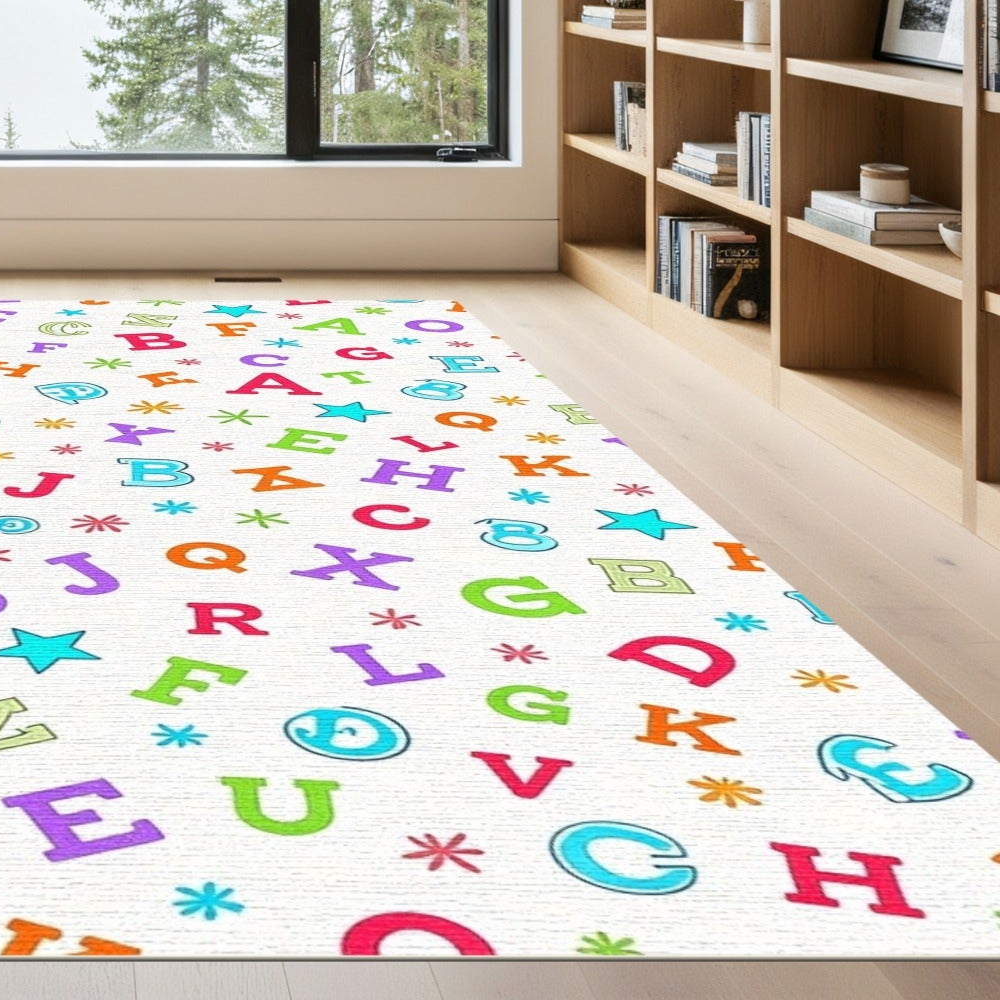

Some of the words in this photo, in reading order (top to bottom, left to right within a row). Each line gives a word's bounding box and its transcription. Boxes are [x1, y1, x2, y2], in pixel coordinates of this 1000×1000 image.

[114, 333, 187, 351] B
[205, 322, 257, 337] F
[292, 317, 366, 335] A
[27, 342, 68, 353] F
[240, 354, 289, 367] C
[335, 347, 394, 360] G
[429, 355, 500, 373] E
[226, 372, 323, 395] A
[434, 411, 498, 432] Q
[266, 428, 348, 455] E
[390, 435, 460, 454] L
[116, 458, 195, 488] B
[360, 458, 465, 493] H
[499, 455, 590, 478] K
[3, 472, 75, 498] J
[352, 504, 431, 531] C
[45, 552, 120, 596] J
[165, 541, 248, 574] Q
[291, 543, 414, 591] X
[587, 557, 696, 595] B
[460, 575, 587, 619] G
[187, 602, 269, 637] R
[331, 643, 445, 687] L
[608, 635, 738, 689] D
[131, 655, 249, 706] F
[485, 684, 571, 726] G
[635, 703, 742, 757] K
[471, 750, 574, 800] V
[3, 778, 165, 863] E
[220, 775, 341, 837] U
[549, 820, 698, 897] C
[770, 841, 926, 920] H
